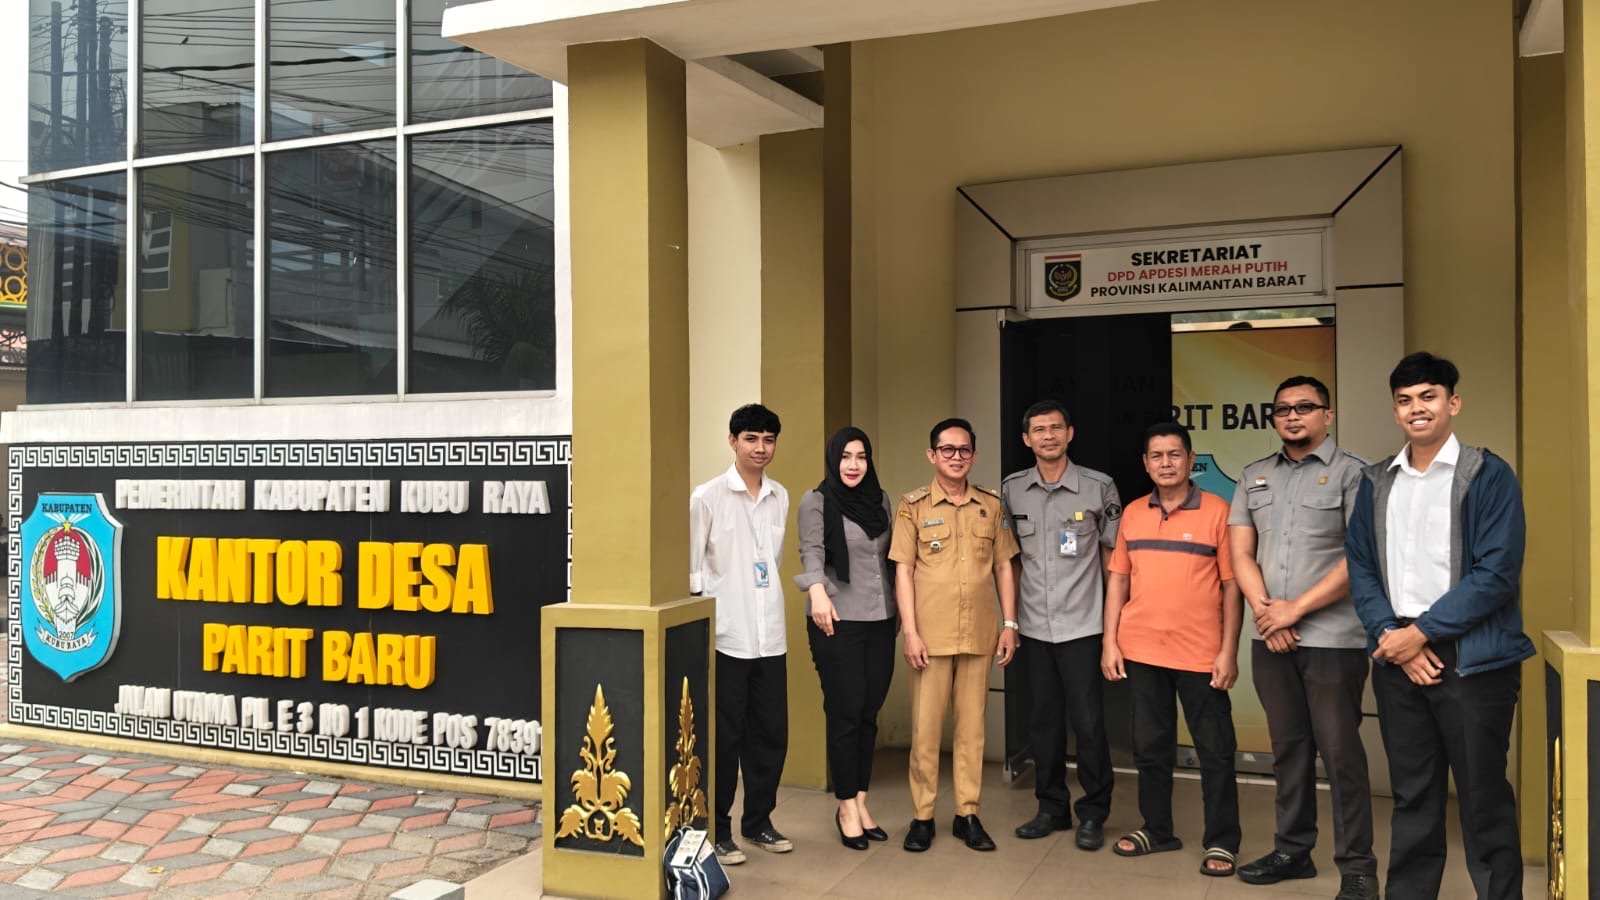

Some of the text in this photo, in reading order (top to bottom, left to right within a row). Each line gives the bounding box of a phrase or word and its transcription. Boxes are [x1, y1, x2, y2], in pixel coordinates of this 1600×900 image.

[1131, 244, 1262, 266] SEKRETARIAT
[1107, 261, 1288, 282] DPD APDESI MERAH PUTIH
[1091, 274, 1306, 297] PROVINSI KALIMANTAN BARAT
[1148, 404, 1213, 430] RIT
[1222, 403, 1277, 430] BAR
[41, 503, 92, 513] KABUPATEN
[115, 479, 551, 514] PEMERINTAH KABUPATEN KUBU RAYA
[157, 536, 494, 615] KANTOR DESA
[203, 623, 436, 689] PARIT BARU
[173, 690, 238, 726] UTAMA
[277, 699, 294, 732] E
[297, 701, 314, 734] 3
[355, 706, 369, 739] 1
[374, 707, 428, 744] KODE
[433, 712, 478, 749] POS
[484, 717, 542, 755] 7839
